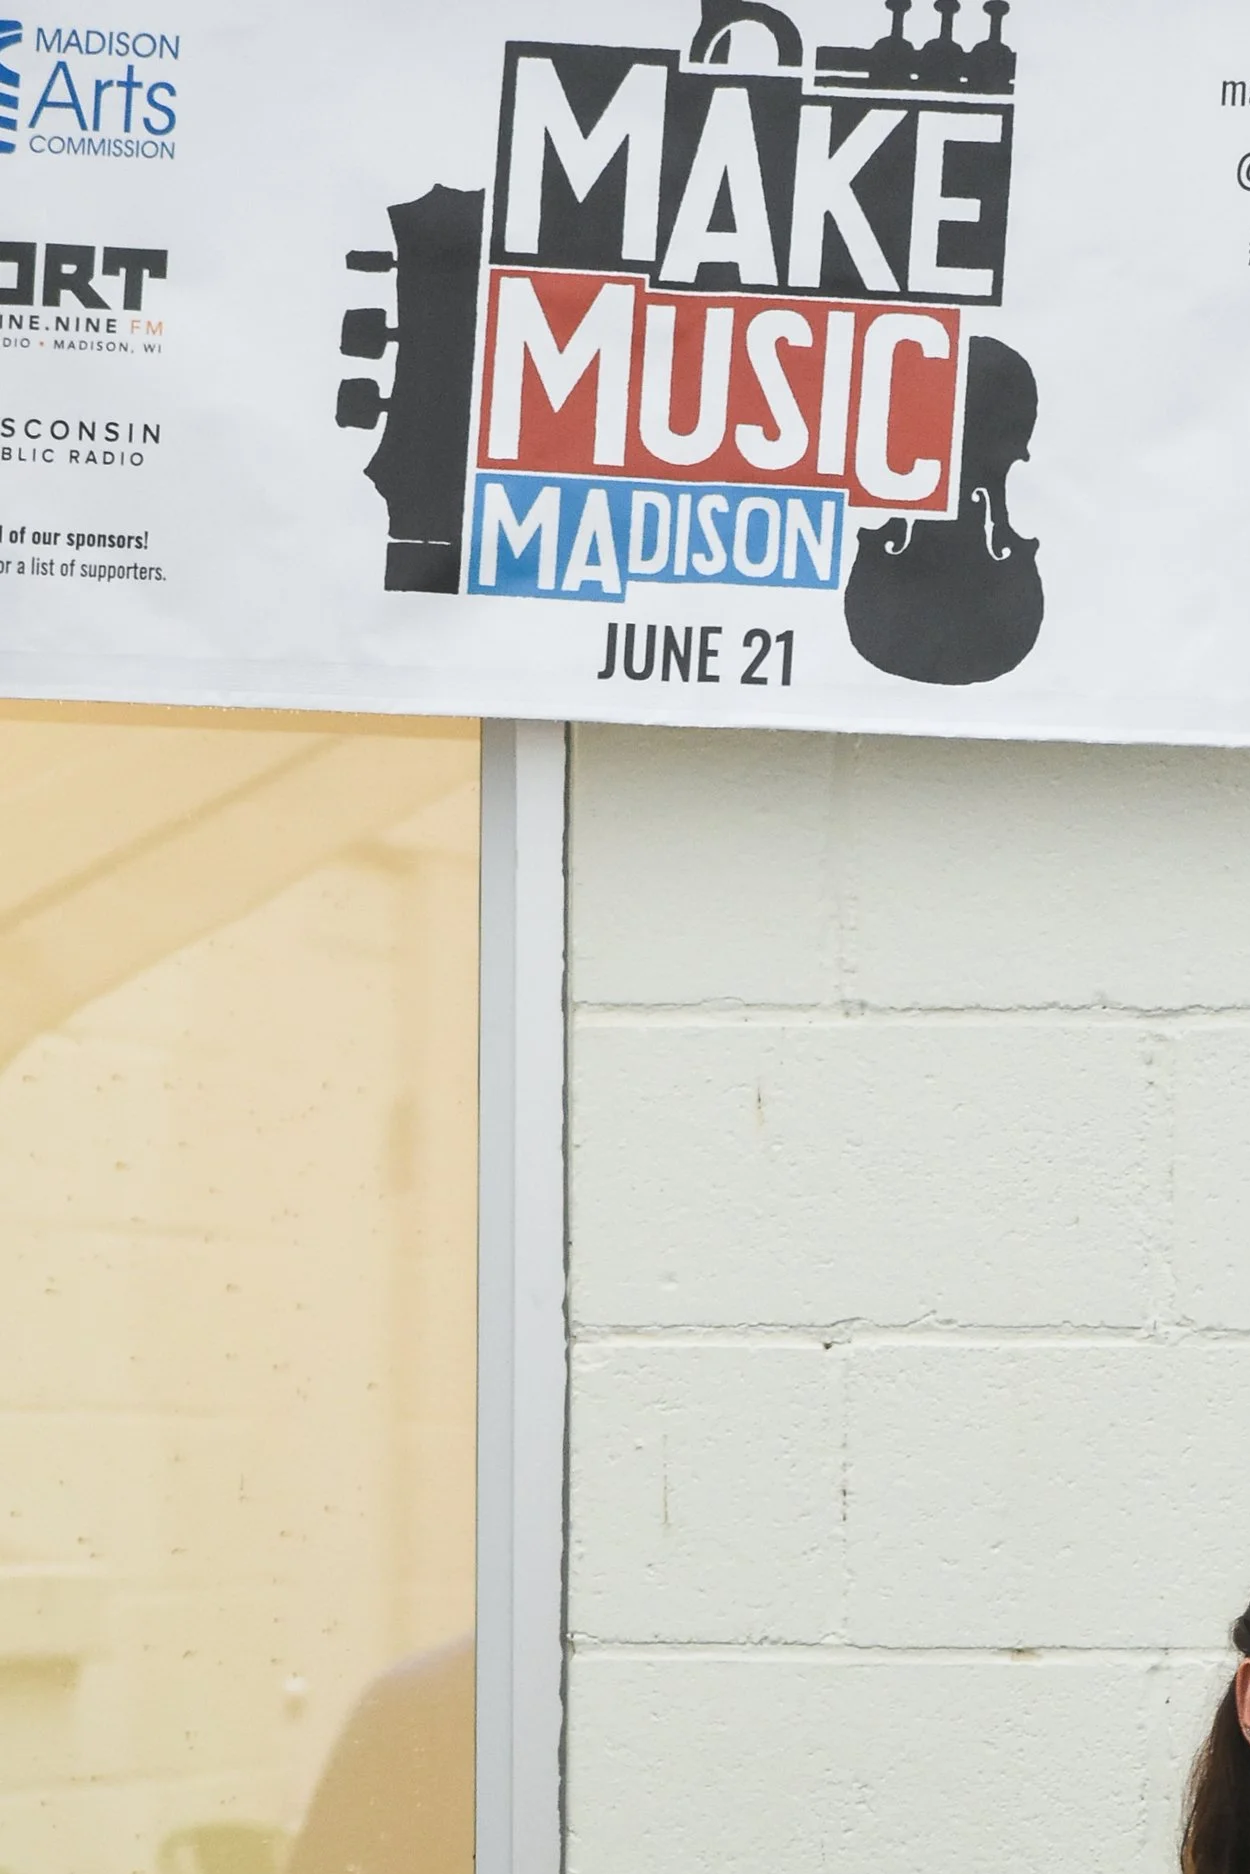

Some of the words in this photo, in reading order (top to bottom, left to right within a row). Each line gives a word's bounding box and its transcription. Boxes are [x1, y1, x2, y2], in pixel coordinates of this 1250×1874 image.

[36, 27, 180, 60] MADISON
[28, 60, 177, 136] Arts
[29, 135, 176, 160] COMMISSION
[504, 57, 1003, 296] MAKE
[130, 320, 164, 336] FM
[53, 339, 135, 354] MADISON,
[143, 343, 162, 354] WI
[487, 276, 951, 502] MUSIC
[1, 418, 161, 444] SCONSIN
[1, 447, 55, 463] BLIC
[69, 450, 144, 466] RADIO
[9, 526, 26, 545] of
[31, 531, 61, 546] our
[66, 531, 149, 551] sponsors!
[478, 483, 836, 594] MADISON
[16, 561, 26, 575] a
[31, 557, 55, 577] list
[60, 558, 76, 577] of
[80, 563, 167, 583] supporters.
[597, 622, 723, 684] JUNE
[739, 627, 796, 687] 21
